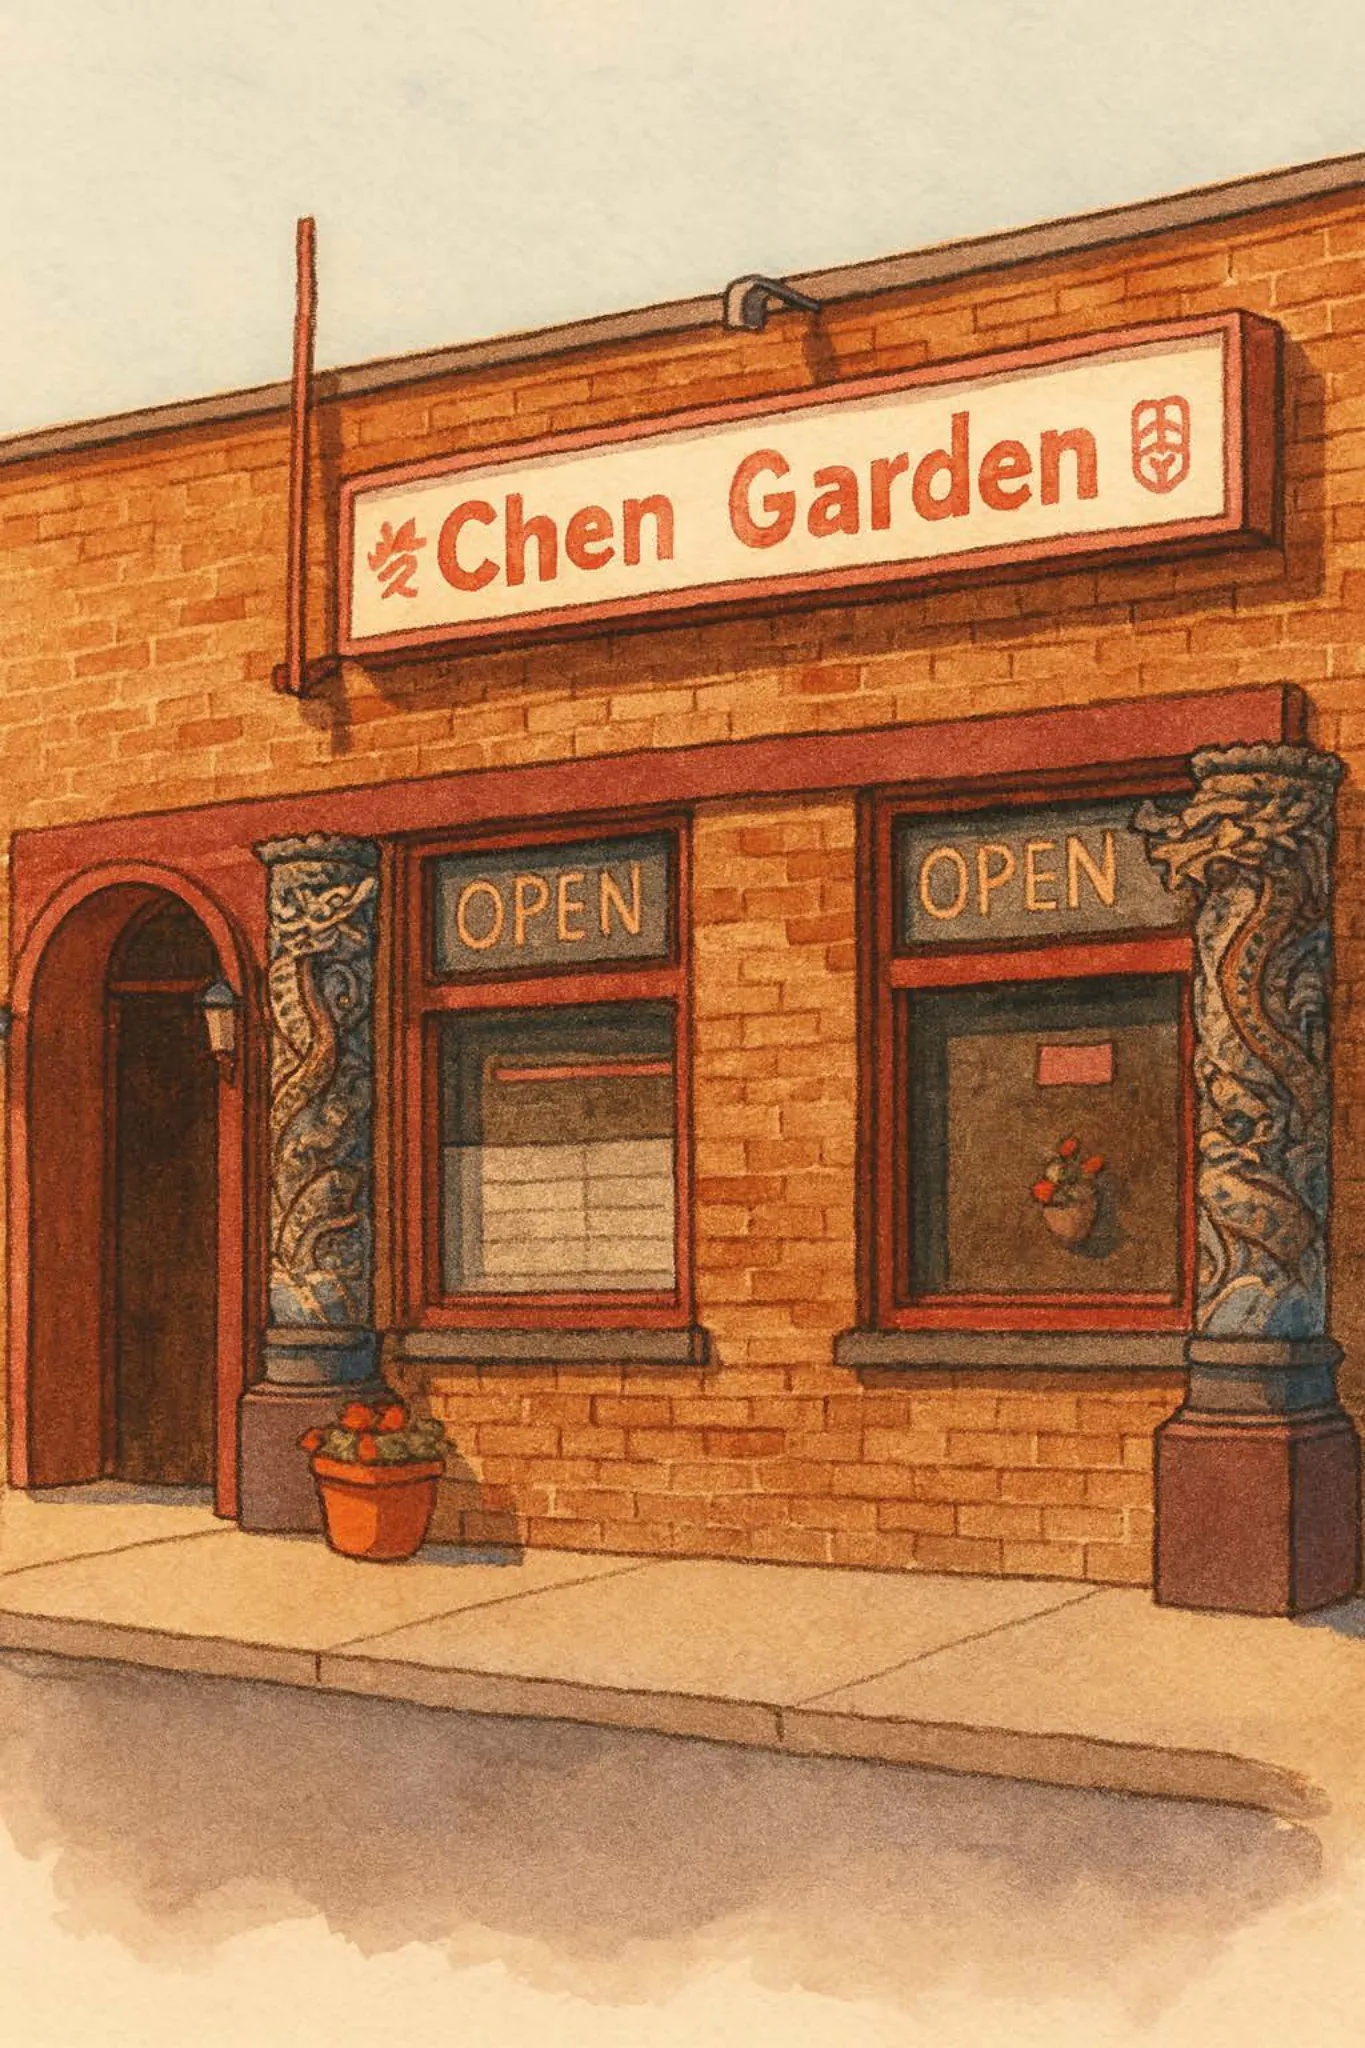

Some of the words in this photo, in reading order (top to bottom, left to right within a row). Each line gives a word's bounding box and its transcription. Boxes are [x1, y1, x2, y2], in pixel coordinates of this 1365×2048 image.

[437, 492, 675, 592] Chen
[728, 411, 1099, 549] Garden
[456, 859, 642, 950] OPEN
[920, 830, 1117, 919] OPEN
